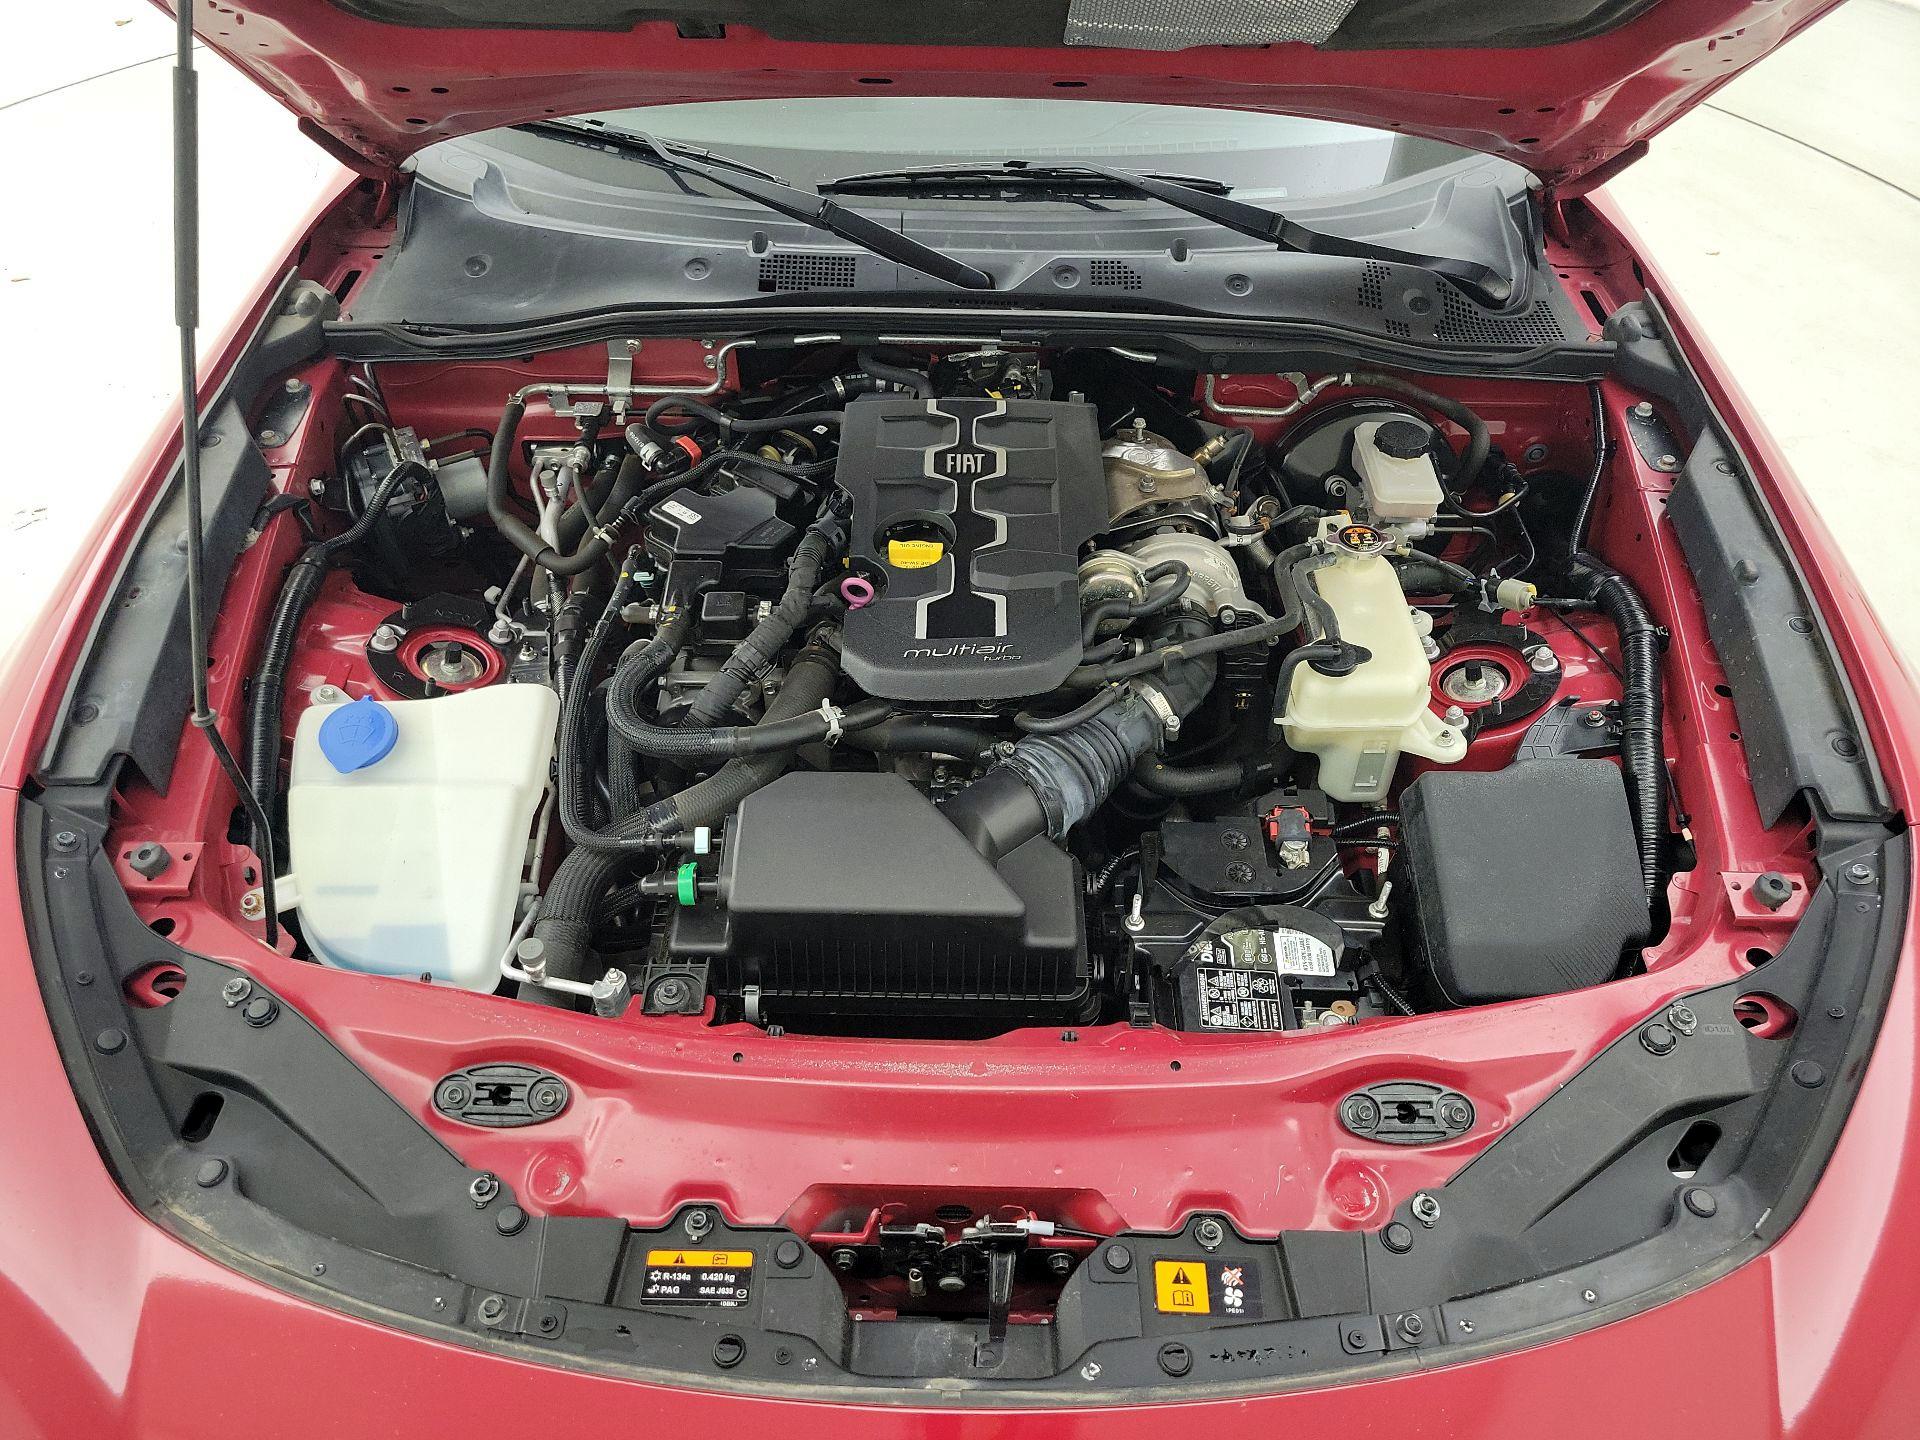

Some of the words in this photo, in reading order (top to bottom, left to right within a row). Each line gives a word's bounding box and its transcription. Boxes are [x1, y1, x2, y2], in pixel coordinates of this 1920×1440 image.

[947, 453, 986, 473] FIAT
[903, 643, 1014, 658] multiair
[662, 1272, 691, 1281] R-134a
[701, 1272, 723, 1281] 0.420
[724, 1273, 735, 1283] kg
[660, 1286, 680, 1294] PAG
[699, 1286, 716, 1294] SAE
